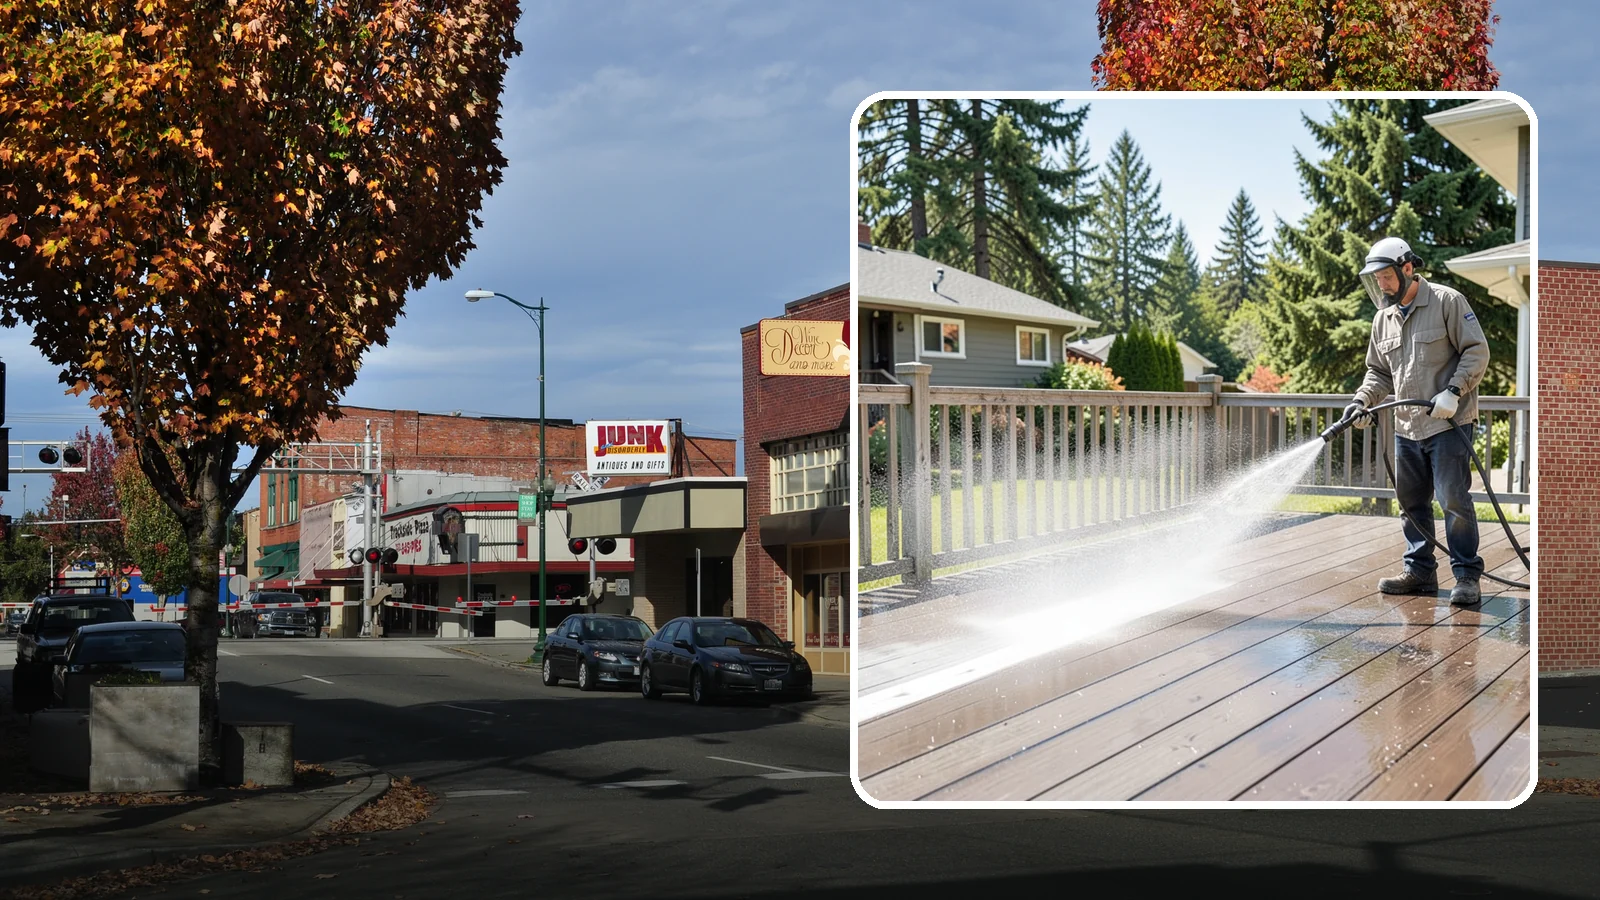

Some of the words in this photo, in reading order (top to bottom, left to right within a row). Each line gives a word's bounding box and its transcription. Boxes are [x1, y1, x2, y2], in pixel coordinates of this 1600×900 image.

[595, 425, 665, 457] JUNK
[596, 461, 628, 470] ANTIQUES
[631, 461, 644, 470] AND
[646, 460, 665, 470] GIFTS
